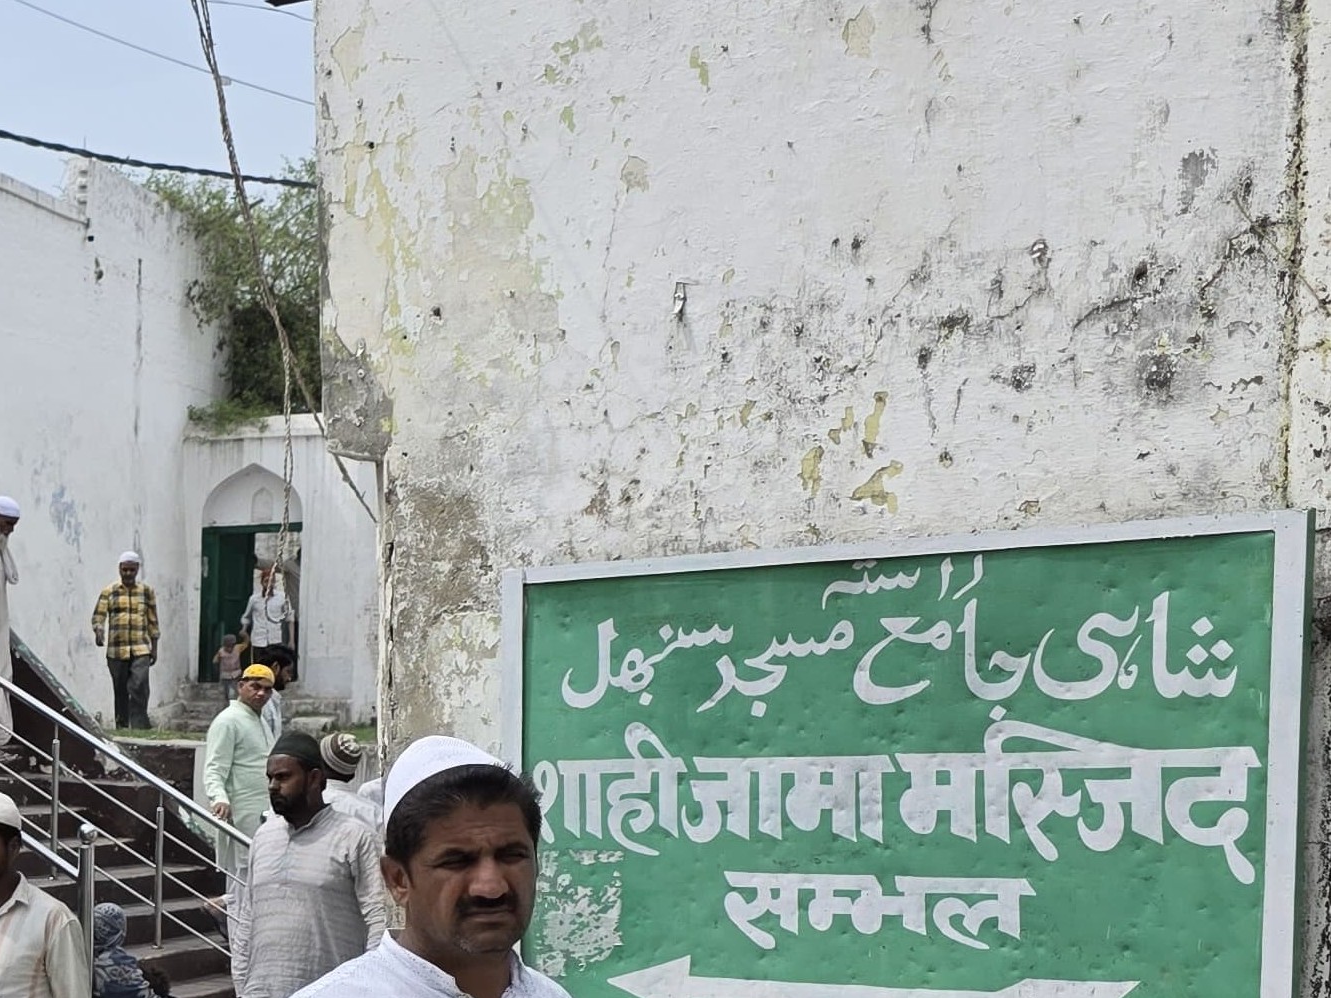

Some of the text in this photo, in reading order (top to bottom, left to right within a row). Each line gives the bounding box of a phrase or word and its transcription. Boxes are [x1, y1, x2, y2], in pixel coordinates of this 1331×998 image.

[561, 591, 1238, 722] شاہی جامع مسجد سنبھل
[532, 719, 1262, 885] शाही जामा मस्जिद
[724, 870, 1037, 950] सम्भल
